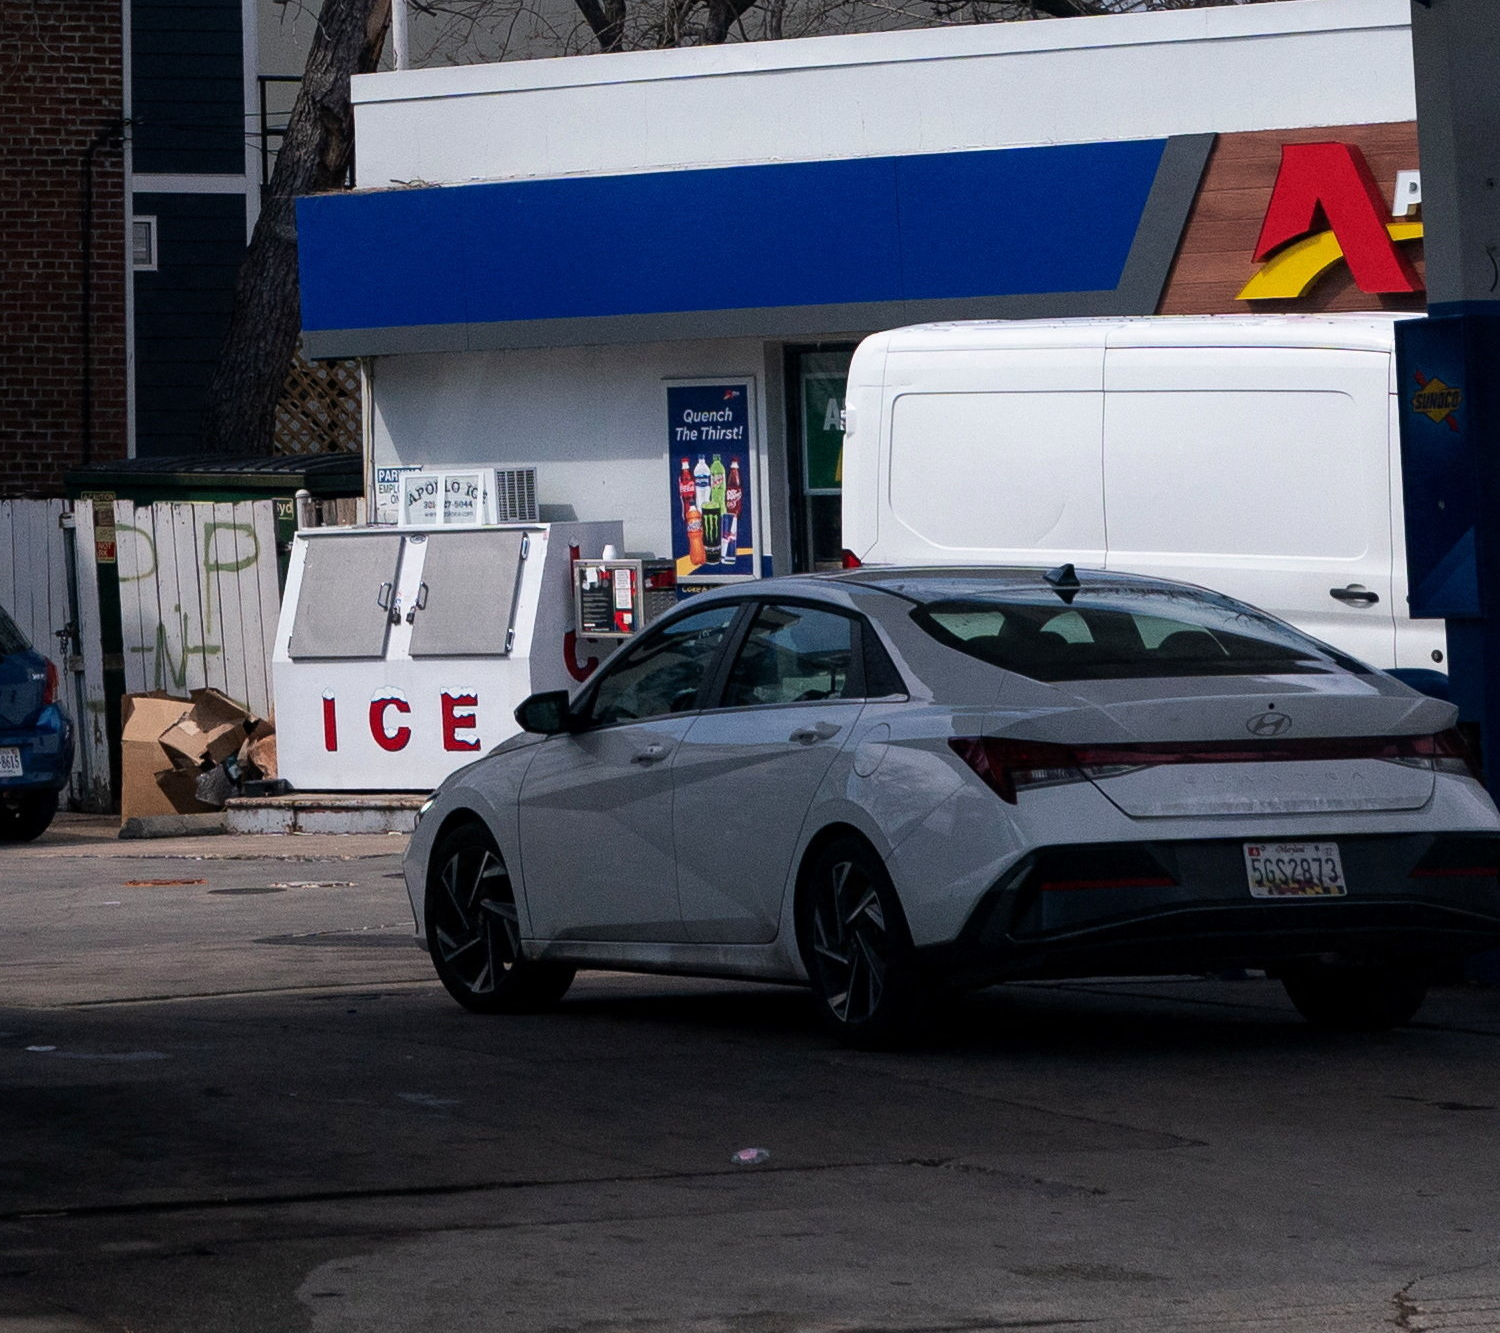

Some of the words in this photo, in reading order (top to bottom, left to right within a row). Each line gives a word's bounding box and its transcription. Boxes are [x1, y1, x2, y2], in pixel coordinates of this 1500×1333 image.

[1414, 390, 1461, 410] SUNOCO
[683, 407, 733, 424] Quench
[675, 427, 698, 442] The
[701, 426, 744, 441] Thirst!
[320, 684, 483, 754] ICE
